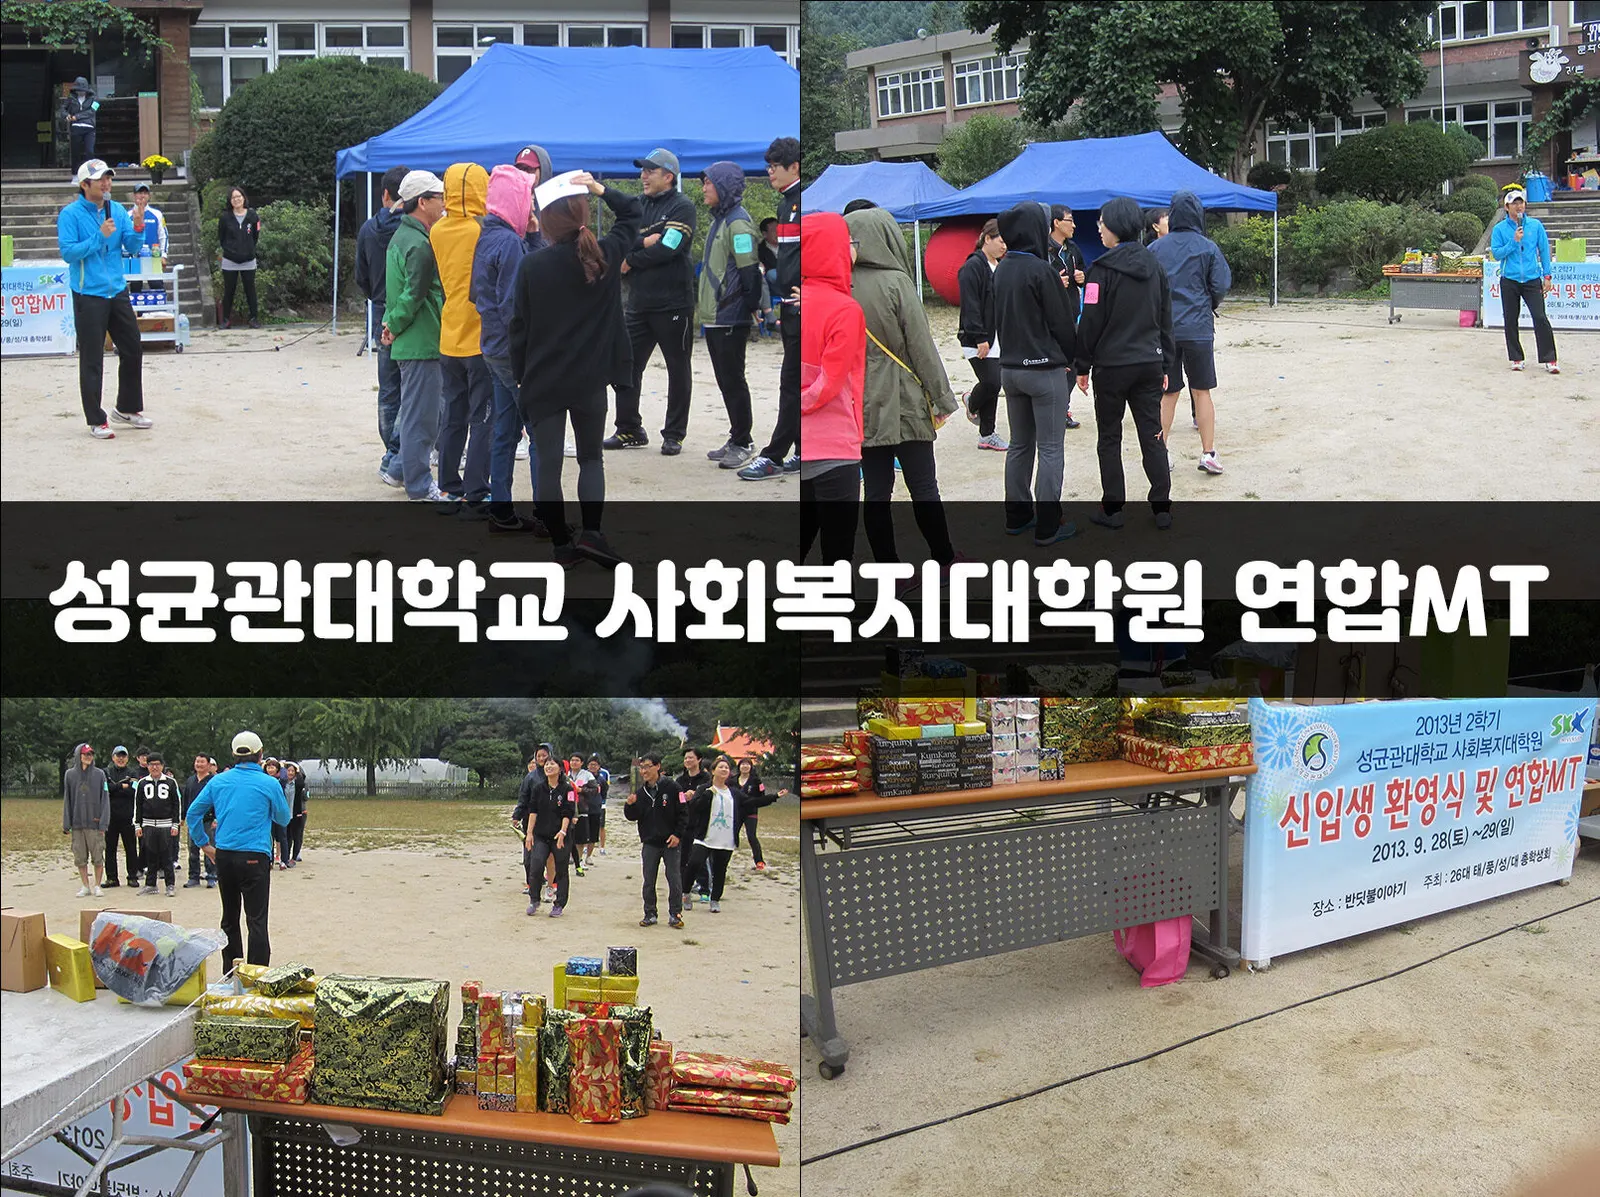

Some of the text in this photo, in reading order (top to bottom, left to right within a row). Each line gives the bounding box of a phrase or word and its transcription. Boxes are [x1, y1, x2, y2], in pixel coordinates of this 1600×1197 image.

[11, 294, 67, 315] 연합MT
[1565, 284, 1576, 299] 및
[1415, 709, 1501, 736] 2013년 2학기
[1550, 707, 1589, 737] SKK
[920, 751, 957, 760] KumKang
[1356, 731, 1543, 773] 성균관대학교 사회복지대학원
[144, 783, 170, 799] 06
[1279, 756, 1583, 849] 신입생 환영식 및 연합MT
[1371, 816, 1515, 863] 2013. 9. 28(토) ~29(일)
[1423, 872, 1442, 889] 주최
[1450, 865, 1470, 884] 26대
[1520, 847, 1552, 867] 총학생회
[1312, 899, 1335, 918] 장소
[1345, 881, 1407, 910] 반딧불이야기
